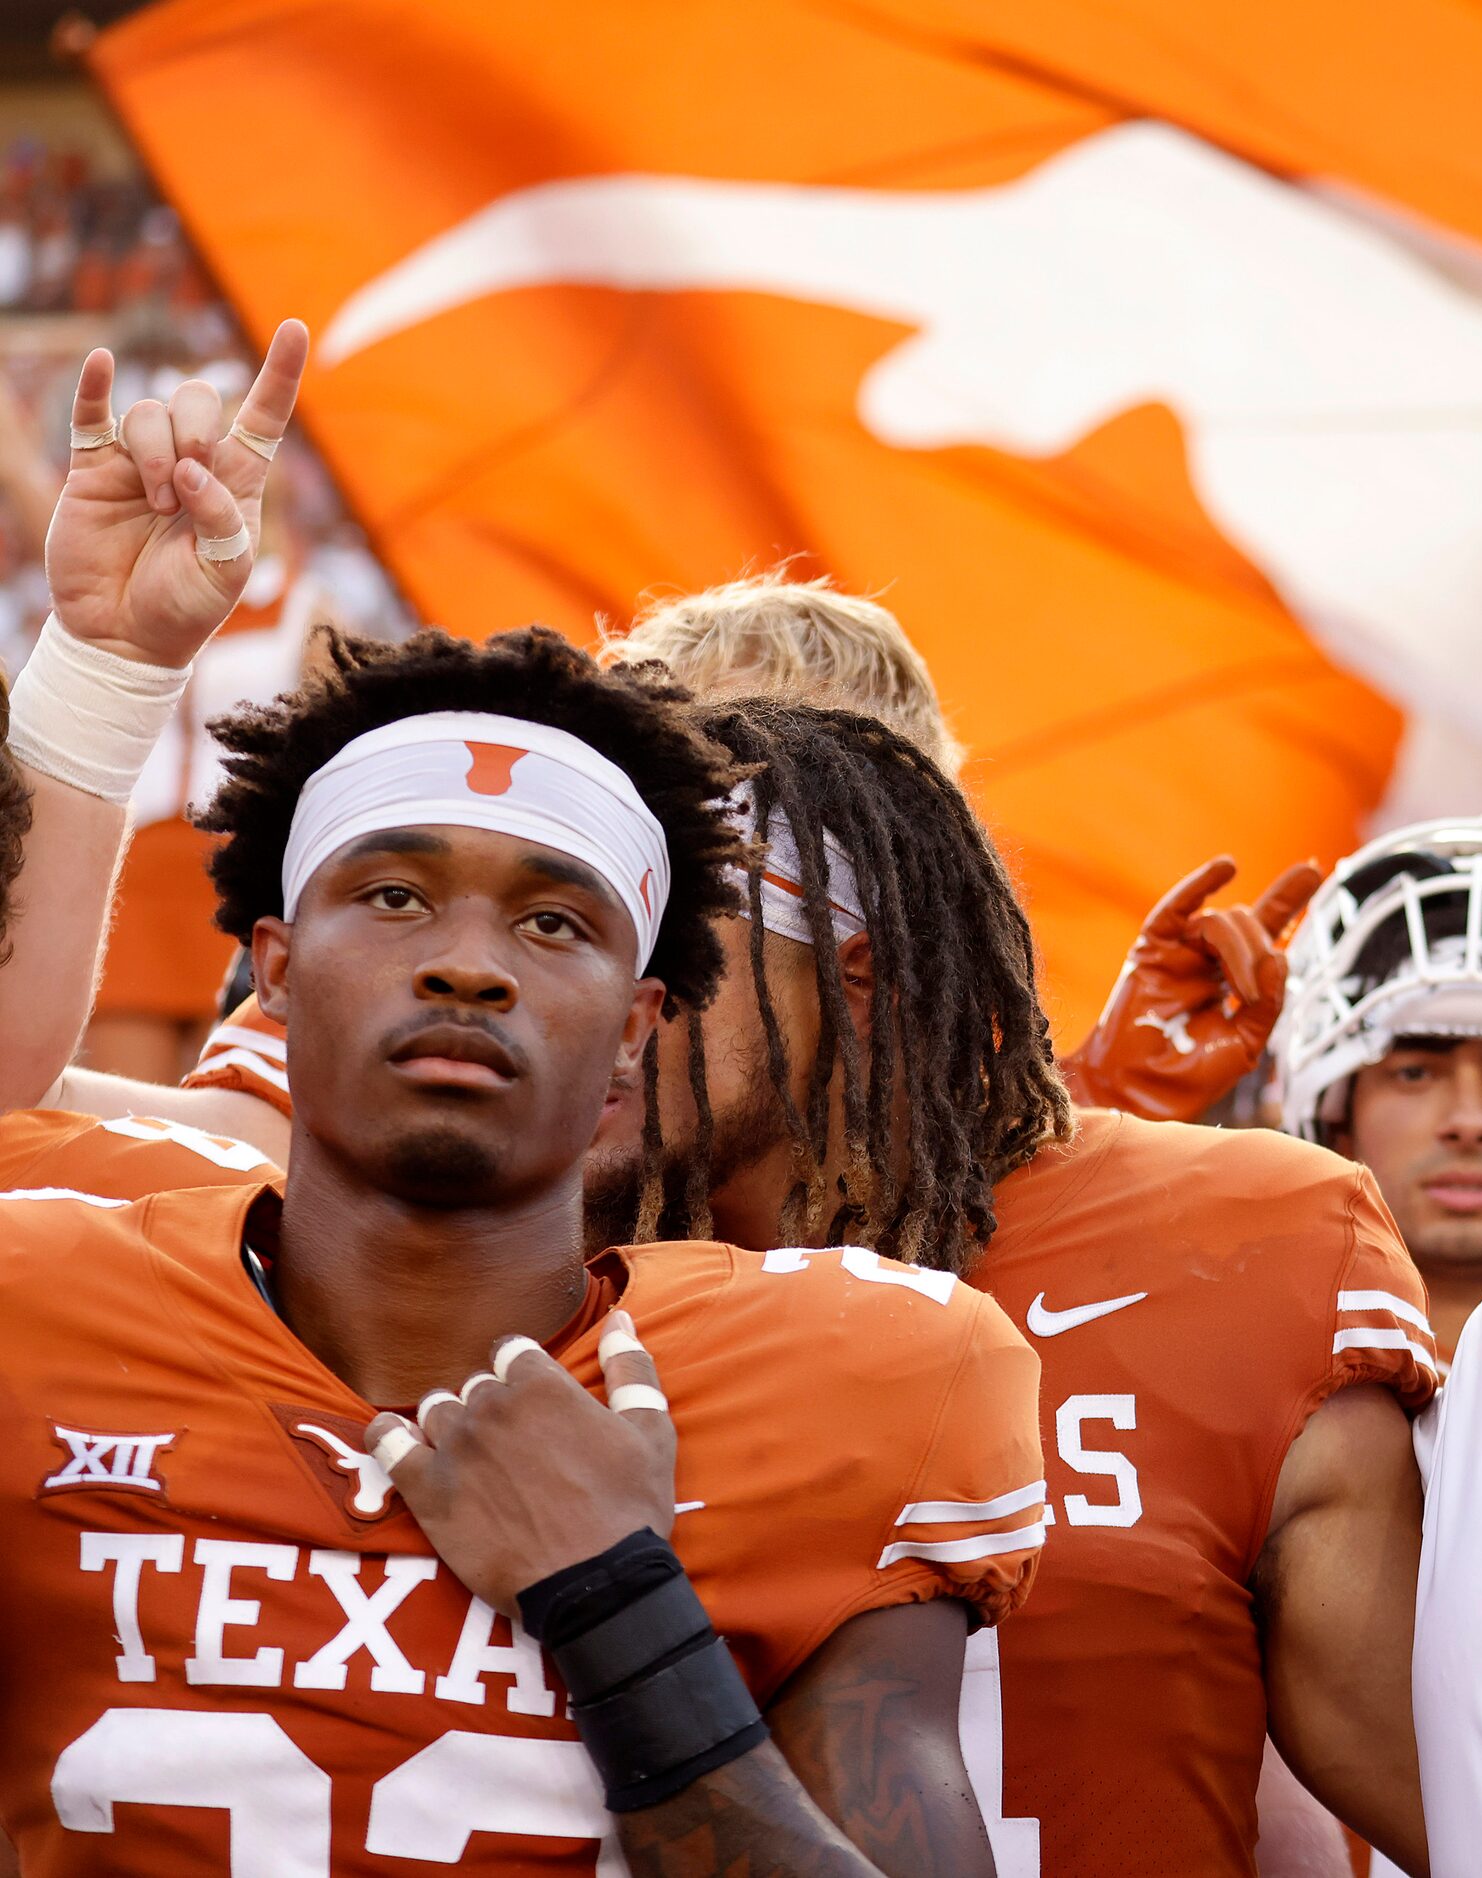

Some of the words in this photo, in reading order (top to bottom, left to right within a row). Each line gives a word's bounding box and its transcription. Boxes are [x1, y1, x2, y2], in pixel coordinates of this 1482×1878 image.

[44, 1425, 176, 1491] XII
[1042, 1394, 1143, 1528] S
[80, 1532, 577, 1721] TEXA
